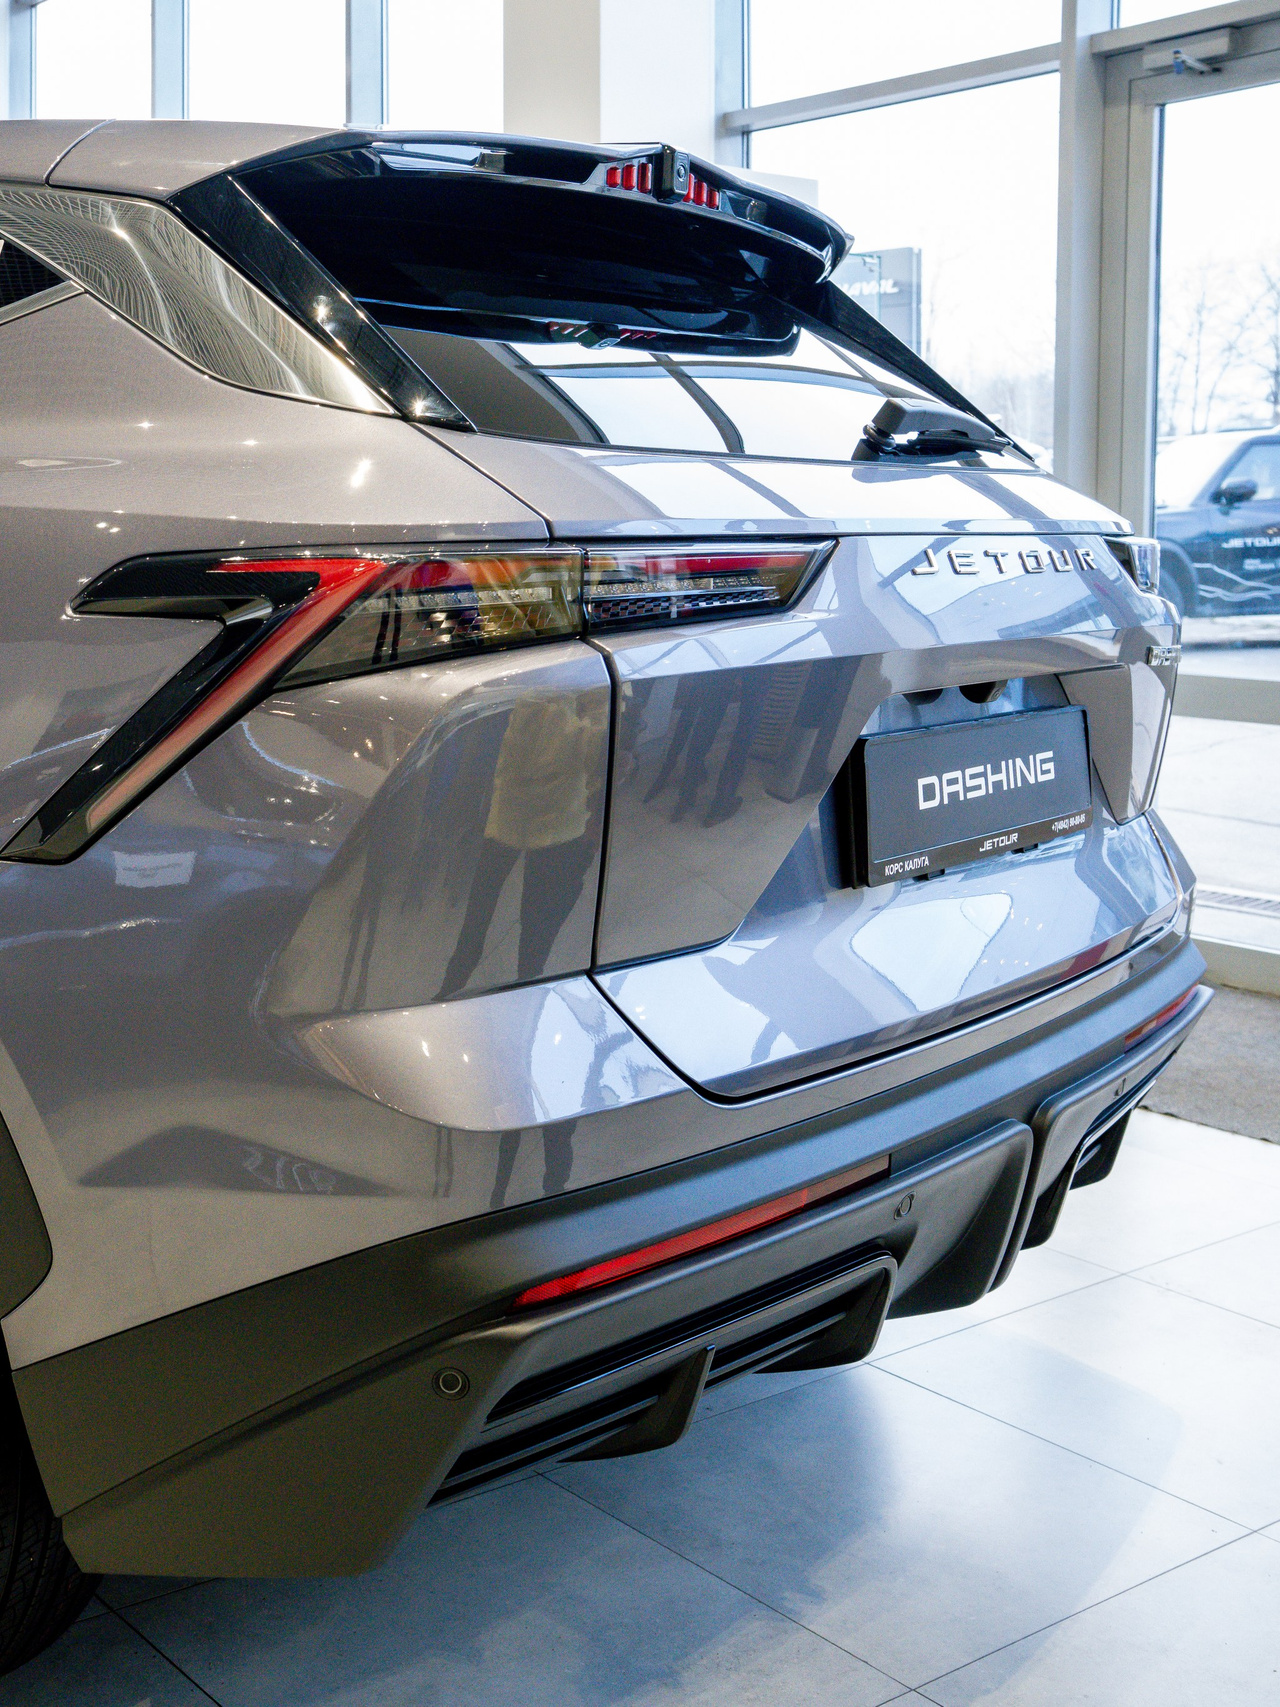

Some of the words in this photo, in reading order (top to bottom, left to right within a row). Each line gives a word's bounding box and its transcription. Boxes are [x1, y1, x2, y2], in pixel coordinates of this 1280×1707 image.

[839, 279, 899, 297] AVAL
[911, 548, 1098, 575] JETOUR
[918, 751, 1055, 810] DASHING
[979, 833, 1018, 852] JETOUR
[884, 861, 904, 877] КОРС
[904, 855, 930, 872] КАЛУГА
